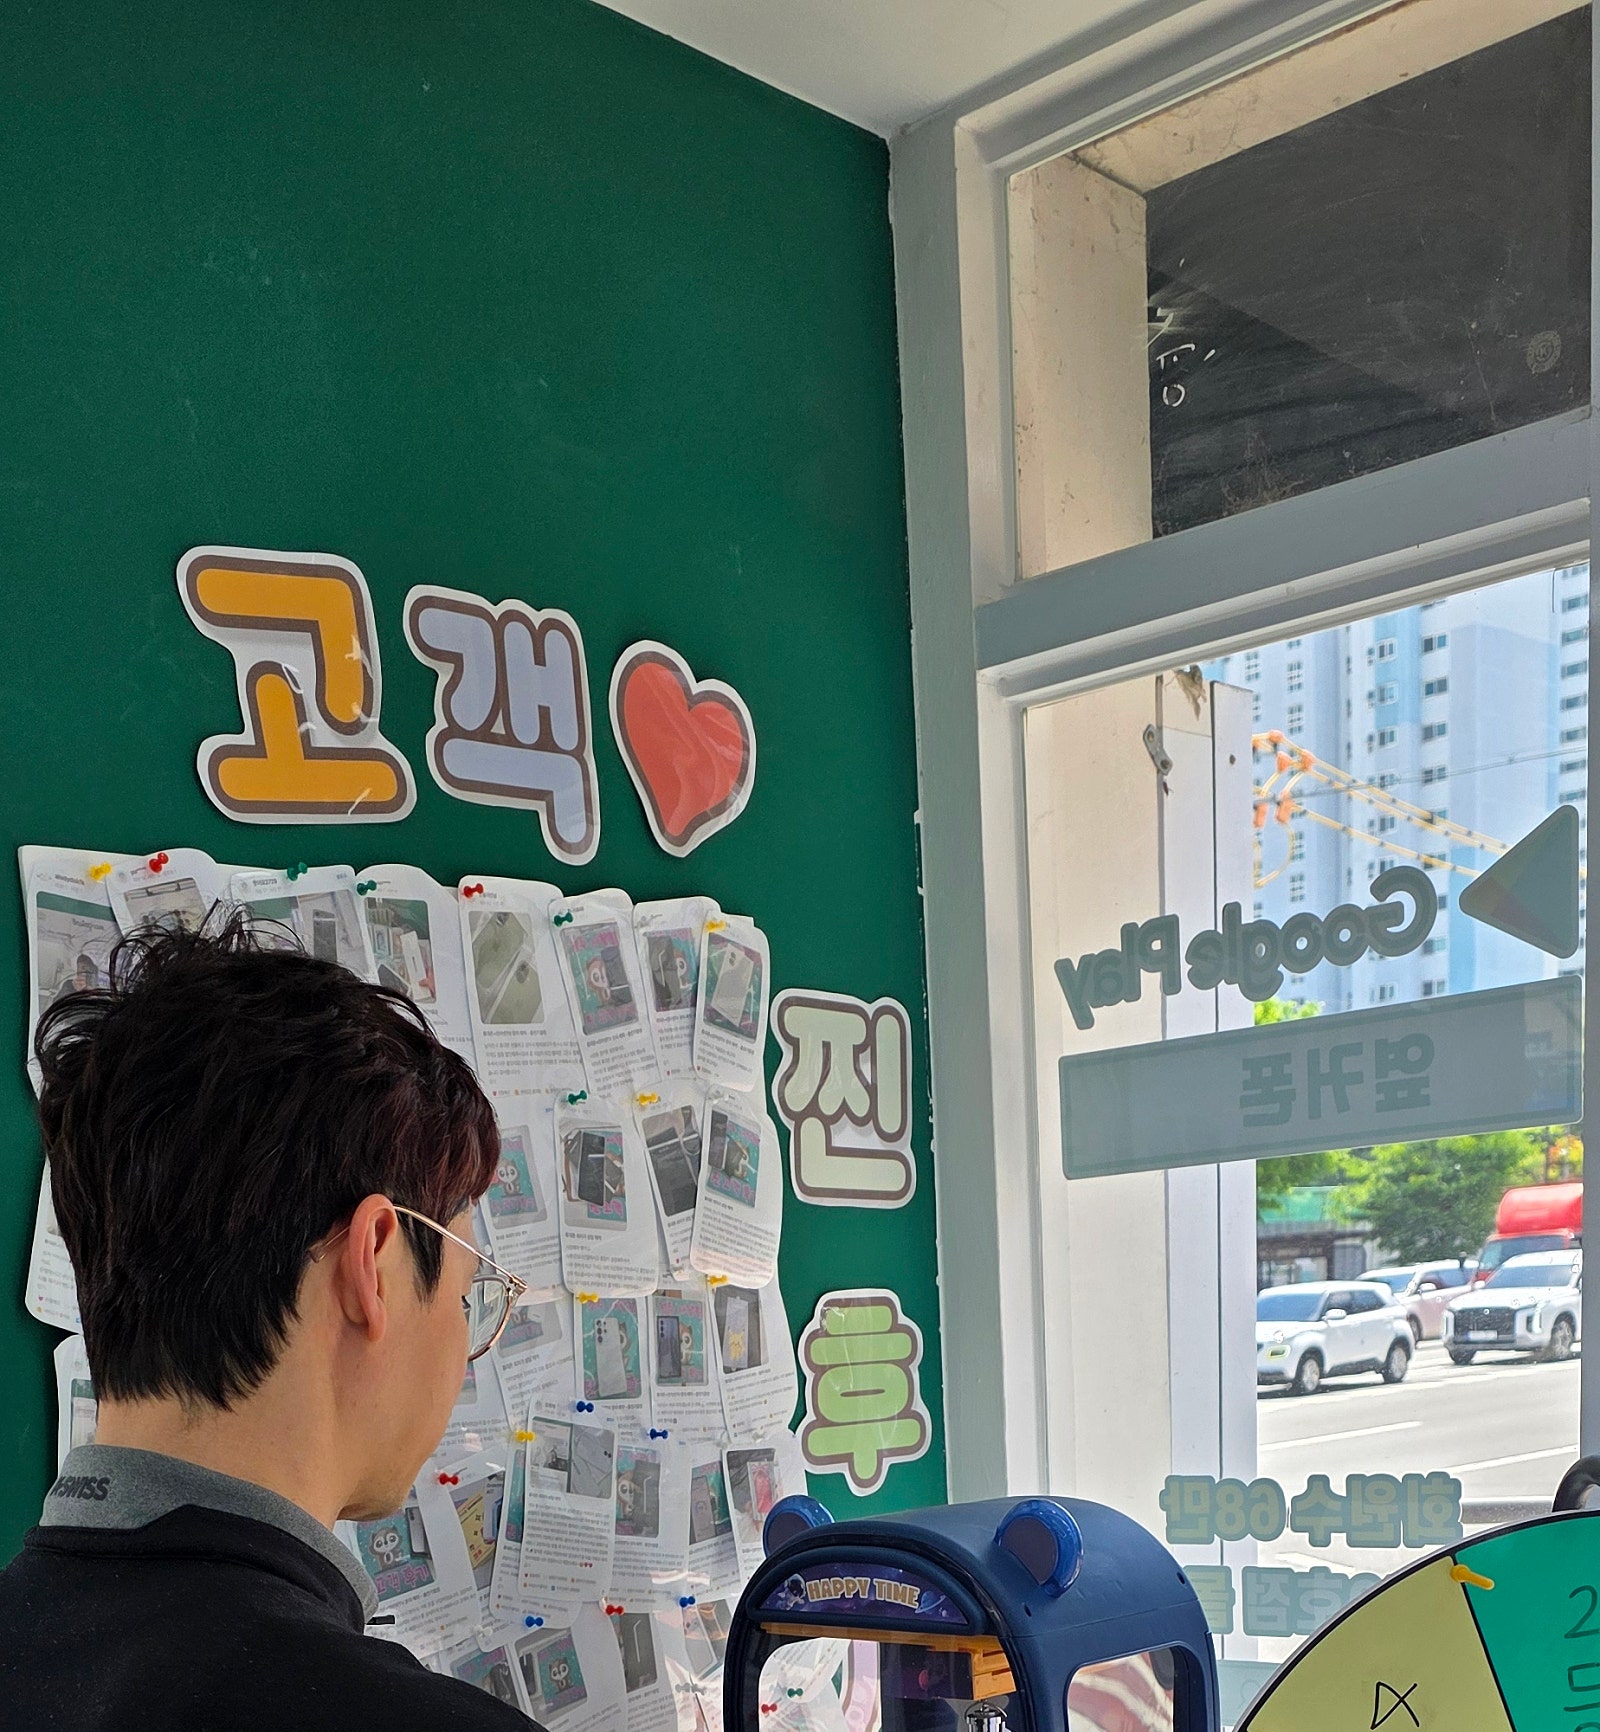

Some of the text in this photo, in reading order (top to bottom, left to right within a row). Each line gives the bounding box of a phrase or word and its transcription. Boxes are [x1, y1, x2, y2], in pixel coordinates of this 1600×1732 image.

[186, 554, 595, 857] 고객
[778, 995, 913, 1200] 찐
[806, 1577, 920, 1609] HAPPY TIME
